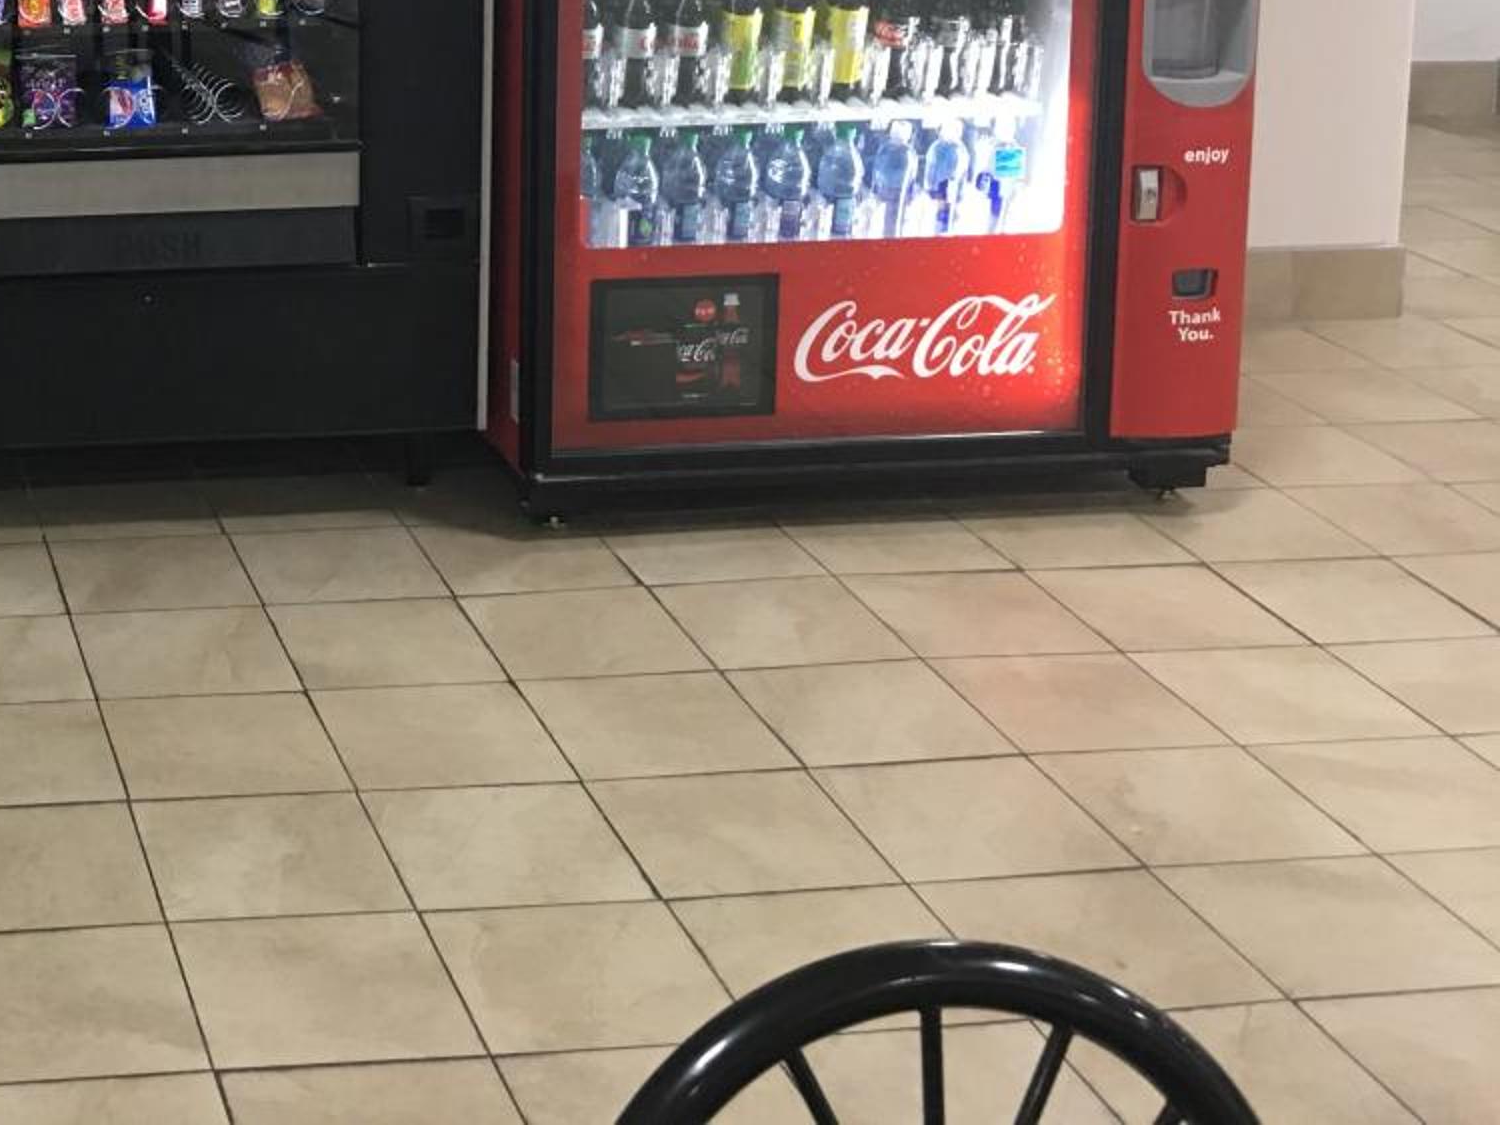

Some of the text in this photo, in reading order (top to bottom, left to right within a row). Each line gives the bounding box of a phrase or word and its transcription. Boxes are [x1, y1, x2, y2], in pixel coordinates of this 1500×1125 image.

[1183, 148, 1230, 165] enjoy
[1168, 308, 1221, 325] Thank
[794, 293, 1056, 382] Coca-Cola
[1178, 327, 1214, 342] You.
